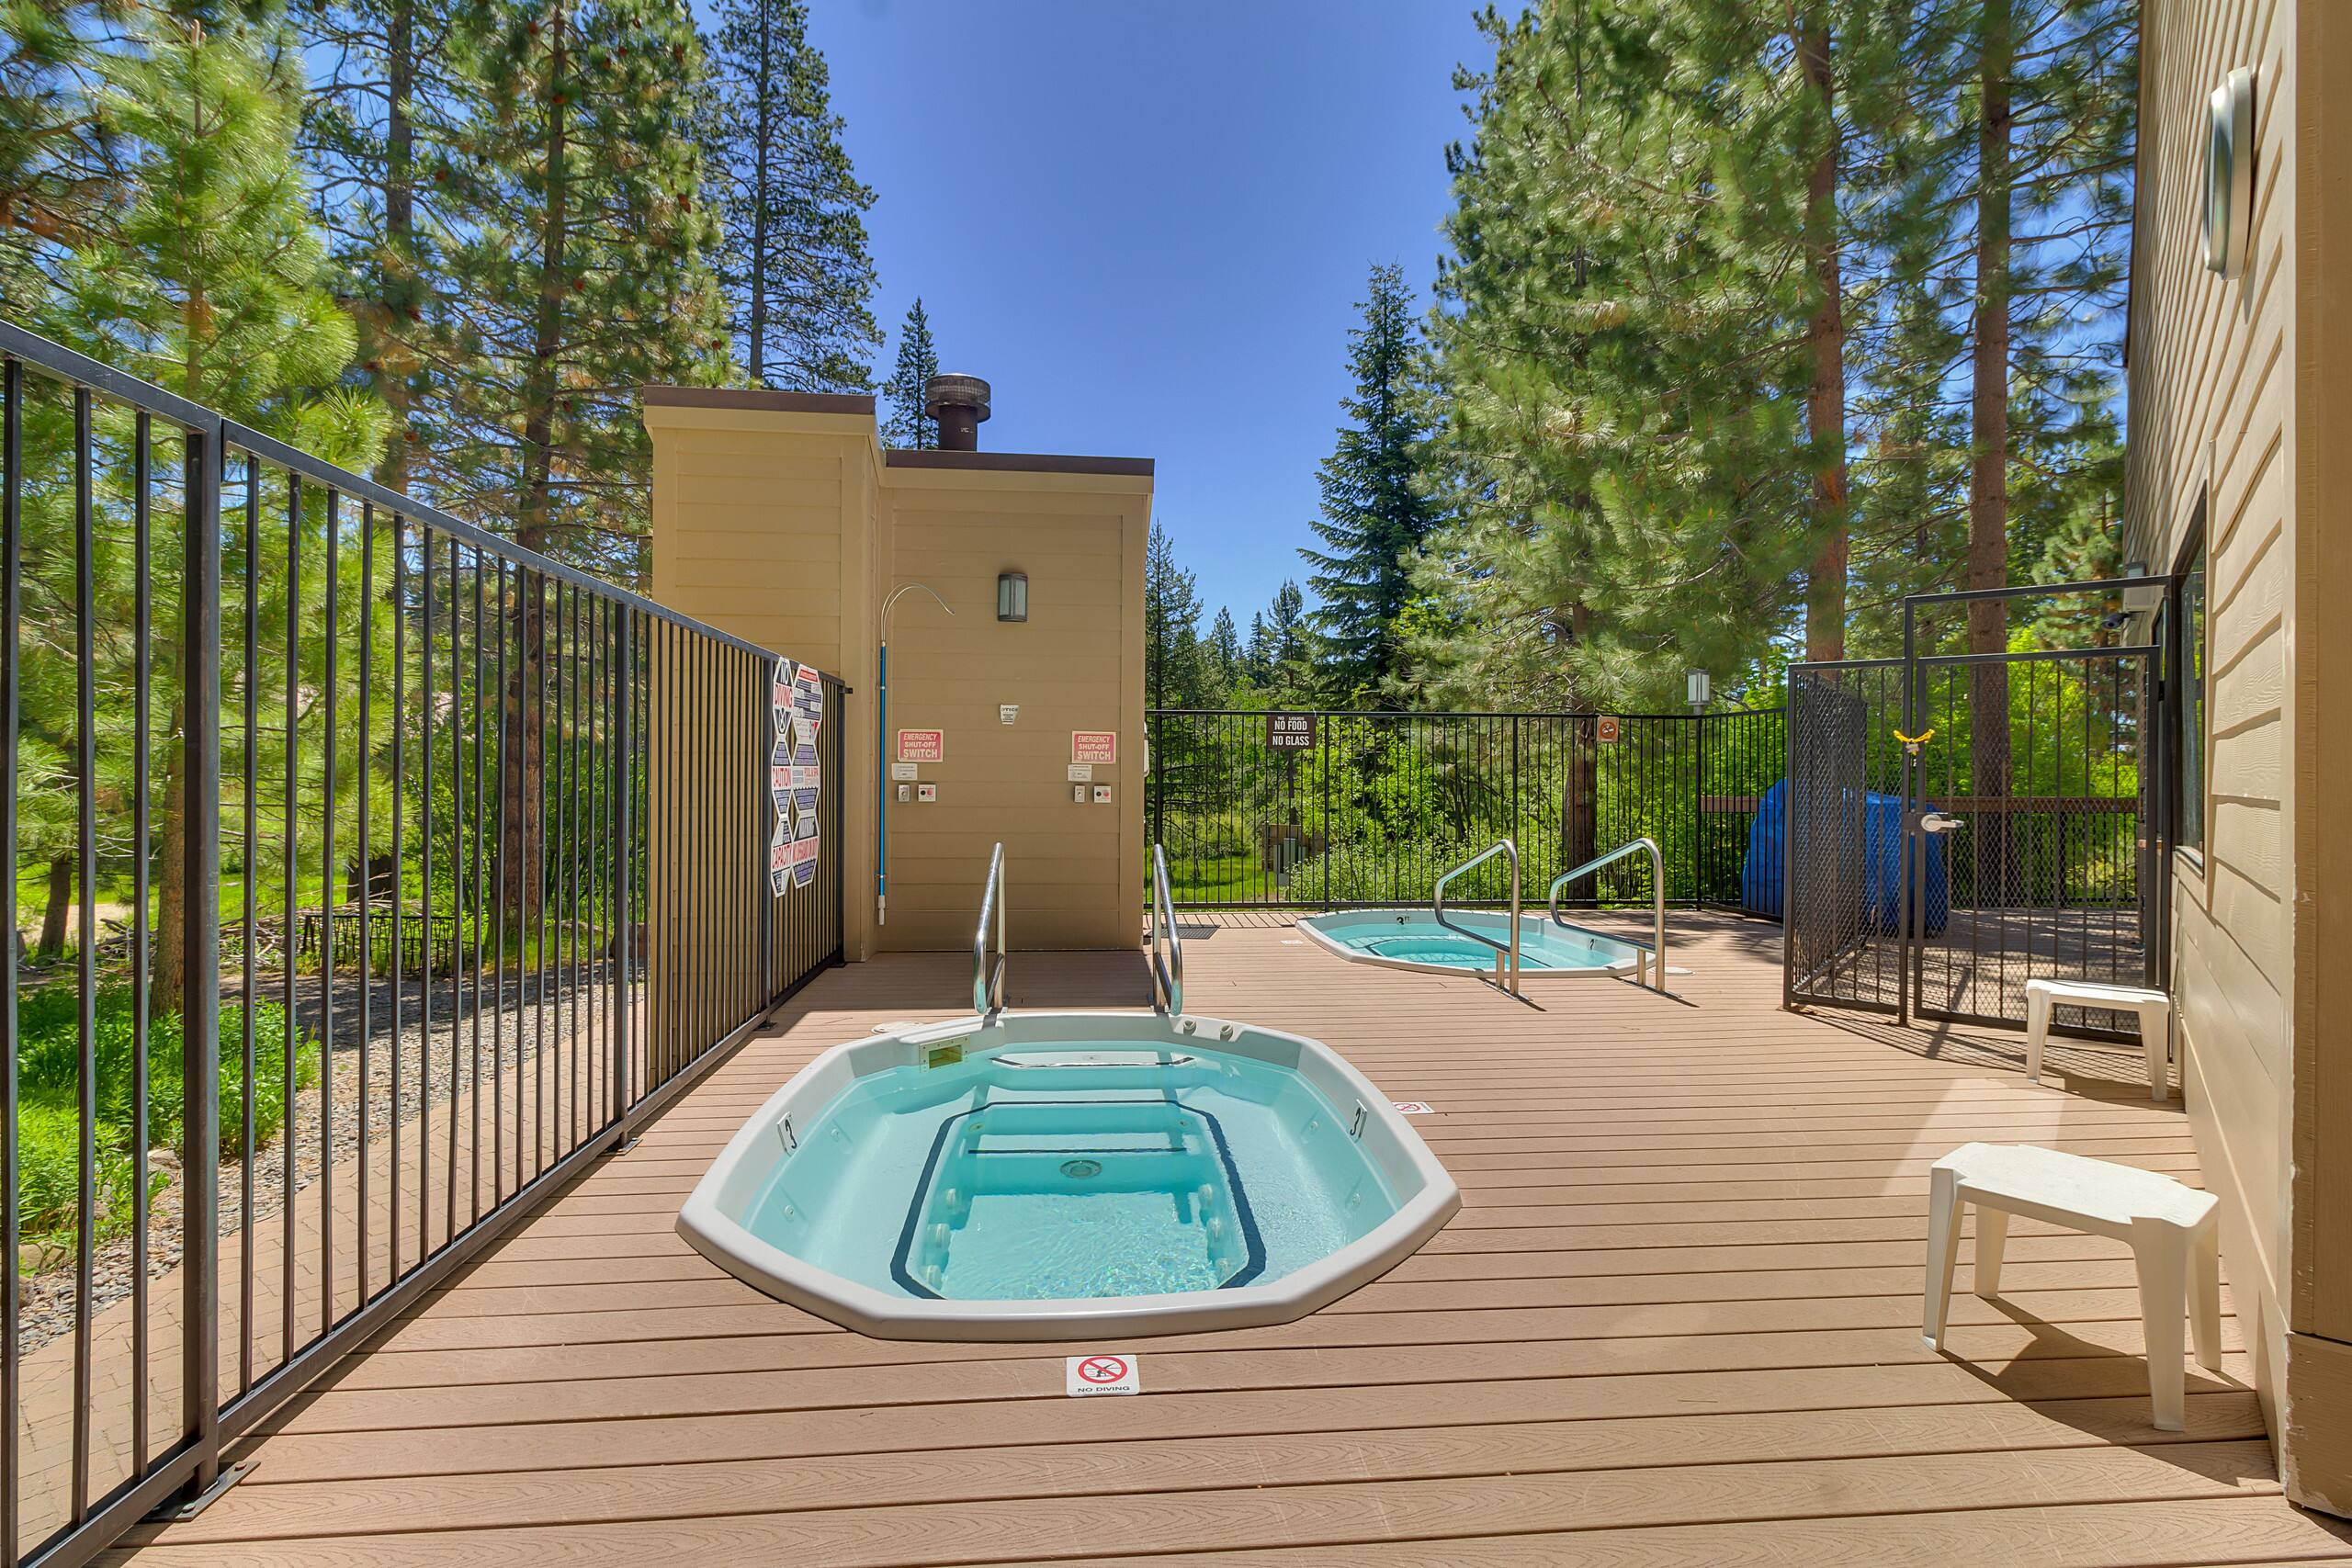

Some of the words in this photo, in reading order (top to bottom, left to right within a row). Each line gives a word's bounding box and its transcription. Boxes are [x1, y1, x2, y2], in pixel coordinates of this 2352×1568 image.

[781, 661, 788, 684] NO
[775, 683, 792, 707] DIVING
[1274, 720, 1285, 730] NO
[1287, 720, 1307, 730] FOOD
[1272, 736, 1283, 746] NO
[1285, 736, 1309, 746] GLASS
[903, 749, 938, 758] SWITCH
[1078, 751, 1111, 760] SWITCH
[773, 767, 791, 787] CAUTION
